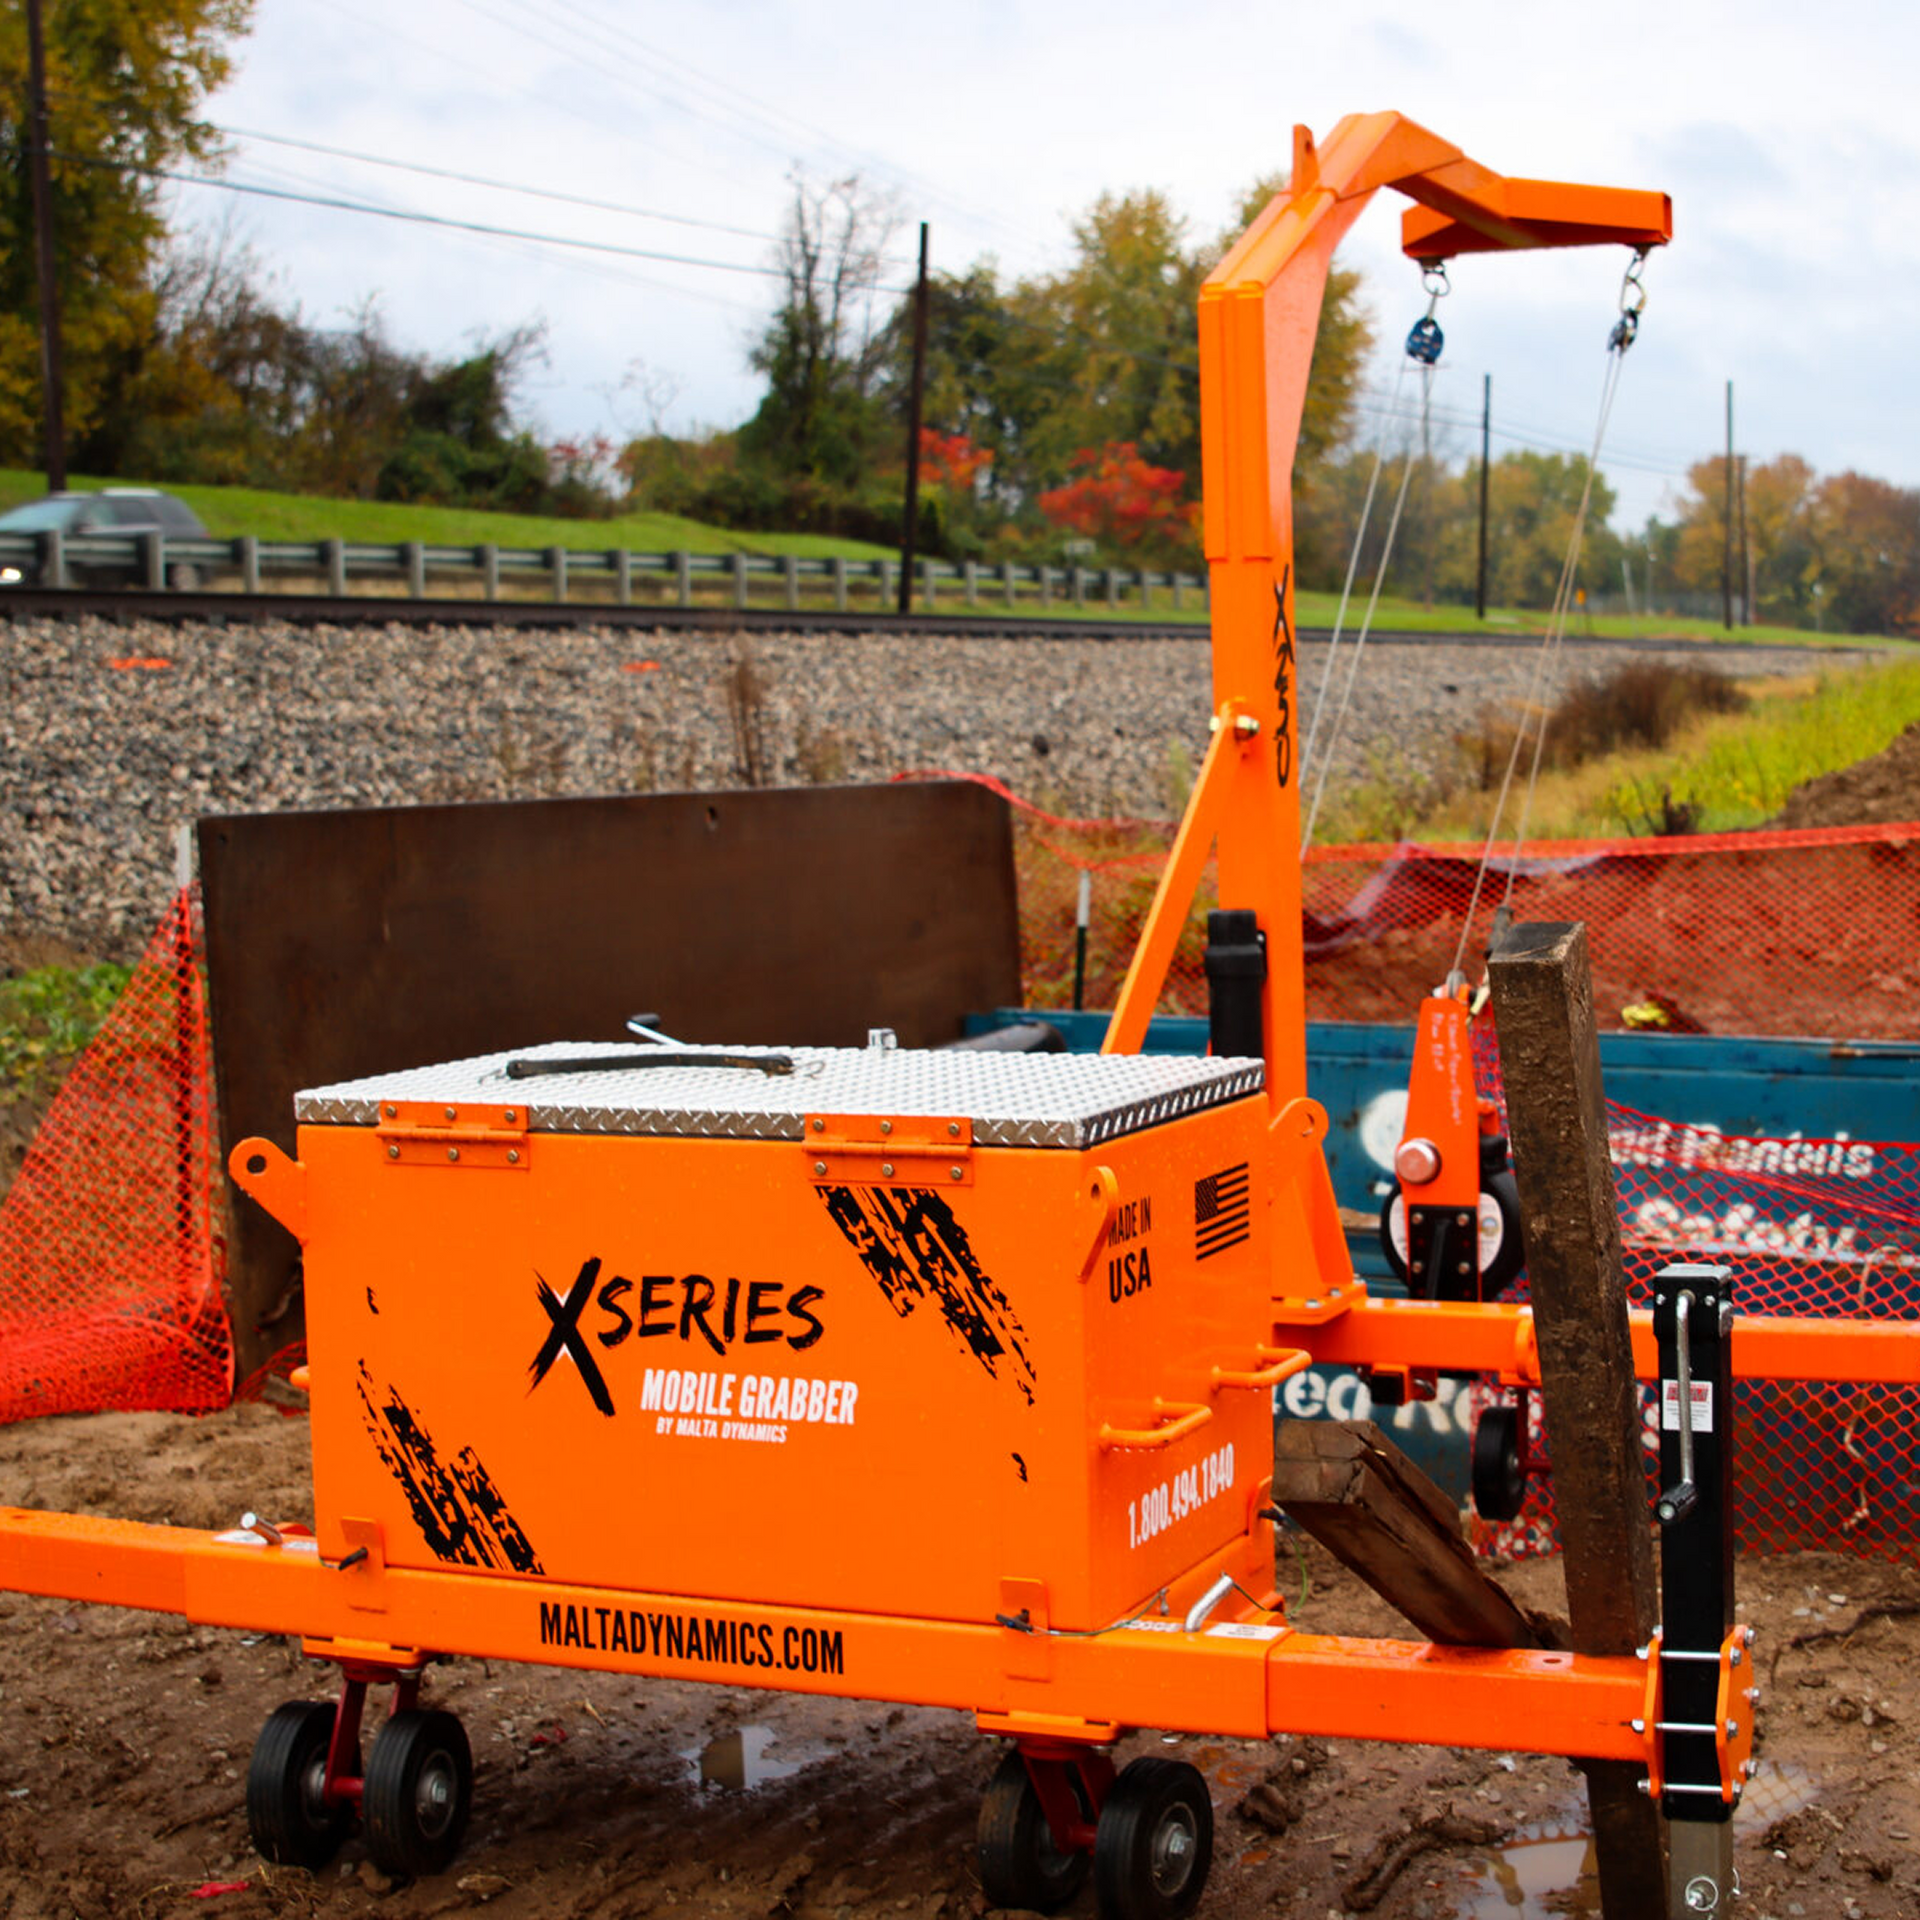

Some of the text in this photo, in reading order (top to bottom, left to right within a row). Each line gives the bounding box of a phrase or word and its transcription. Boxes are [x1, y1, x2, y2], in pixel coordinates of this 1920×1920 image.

[1108, 1195, 1151, 1248] MADE IN
[1109, 1247, 1152, 1304] USA
[640, 1368, 859, 1425] MOBILE GRABBER
[655, 1416, 788, 1444] BY MALTA DYNAMICS
[1128, 1441, 1235, 1550] 1.800.494.1840
[540, 1602, 844, 1674] MALTADYNAMICS.COM
